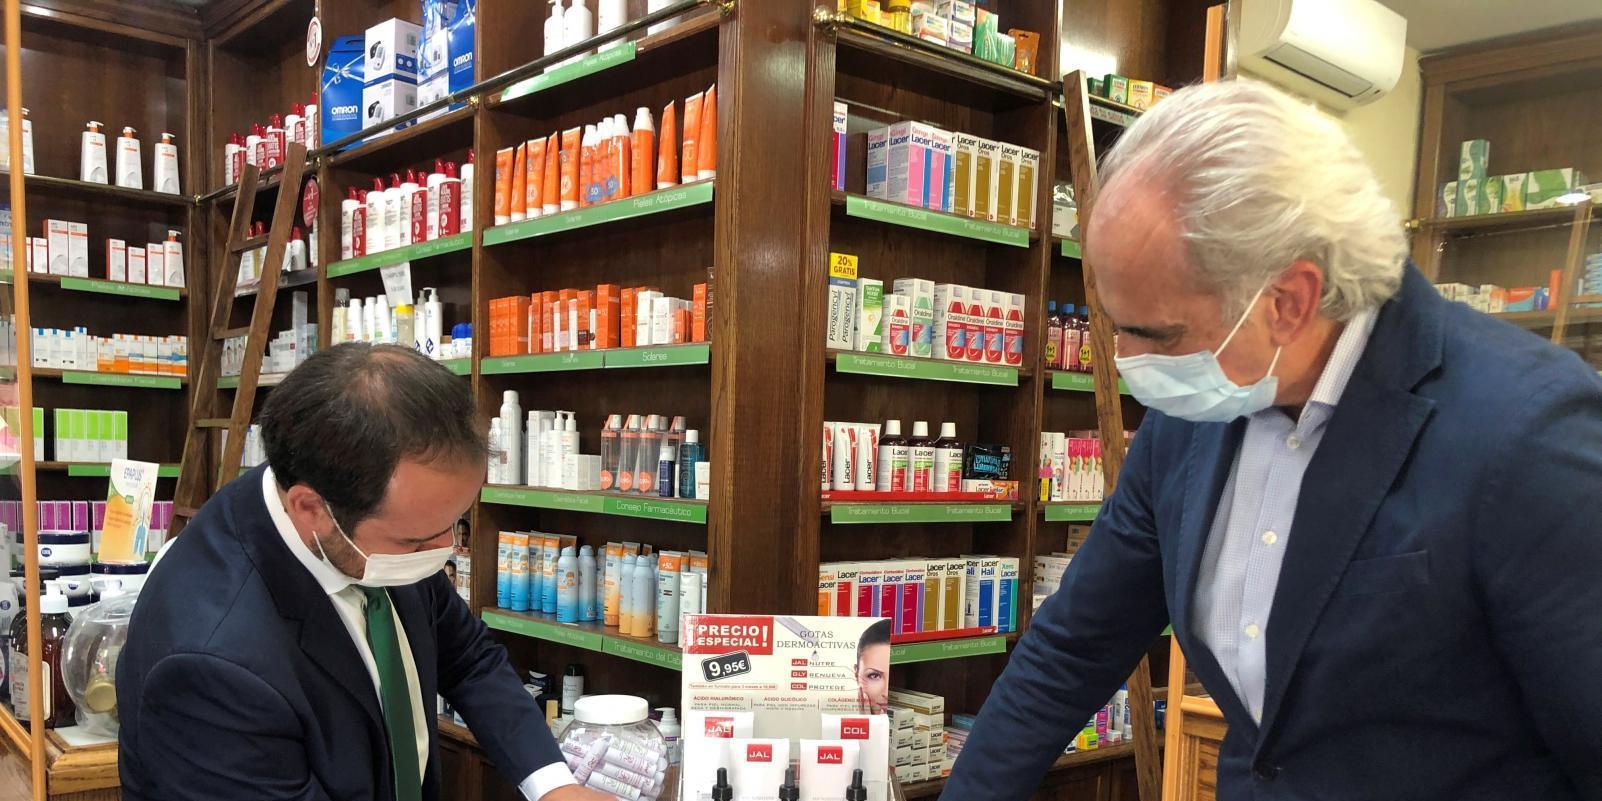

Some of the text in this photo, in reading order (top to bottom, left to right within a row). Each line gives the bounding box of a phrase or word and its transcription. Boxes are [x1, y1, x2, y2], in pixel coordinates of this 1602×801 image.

[453, 52, 473, 67] OMRON
[331, 105, 359, 115] OMRON
[889, 136, 909, 146] Lacer
[912, 134, 931, 145] Lacer
[958, 135, 976, 146] Lacer
[868, 140, 887, 150] Lacer
[931, 141, 951, 152] Lacer
[978, 140, 996, 151] Lacer
[1001, 144, 1019, 156] Lacer
[1021, 149, 1039, 161] Lacer
[633, 198, 653, 208] Pieles
[834, 265, 855, 276] GRATIS
[642, 352, 668, 361] Solares
[843, 460, 851, 484] Lacer
[616, 501, 692, 517] Consejo Farmacéutico
[926, 563, 946, 571] Lacer
[946, 562, 966, 570] Lacer
[981, 560, 999, 568] Lacer
[837, 570, 858, 579] Lacer
[966, 566, 975, 576] ali
[981, 567, 995, 576] Hali
[858, 575, 880, 583] Lacer
[883, 574, 903, 582] Lacer
[905, 573, 924, 581] Lacer
[698, 624, 760, 636] PRECIO
[800, 630, 834, 639] GOTAS
[697, 637, 759, 647] ESPECIAL
[776, 640, 856, 649] DERMOACTIVAS
[667, 653, 681, 665] Cab
[708, 659, 747, 678] 9,95€
[843, 727, 867, 735] COL
